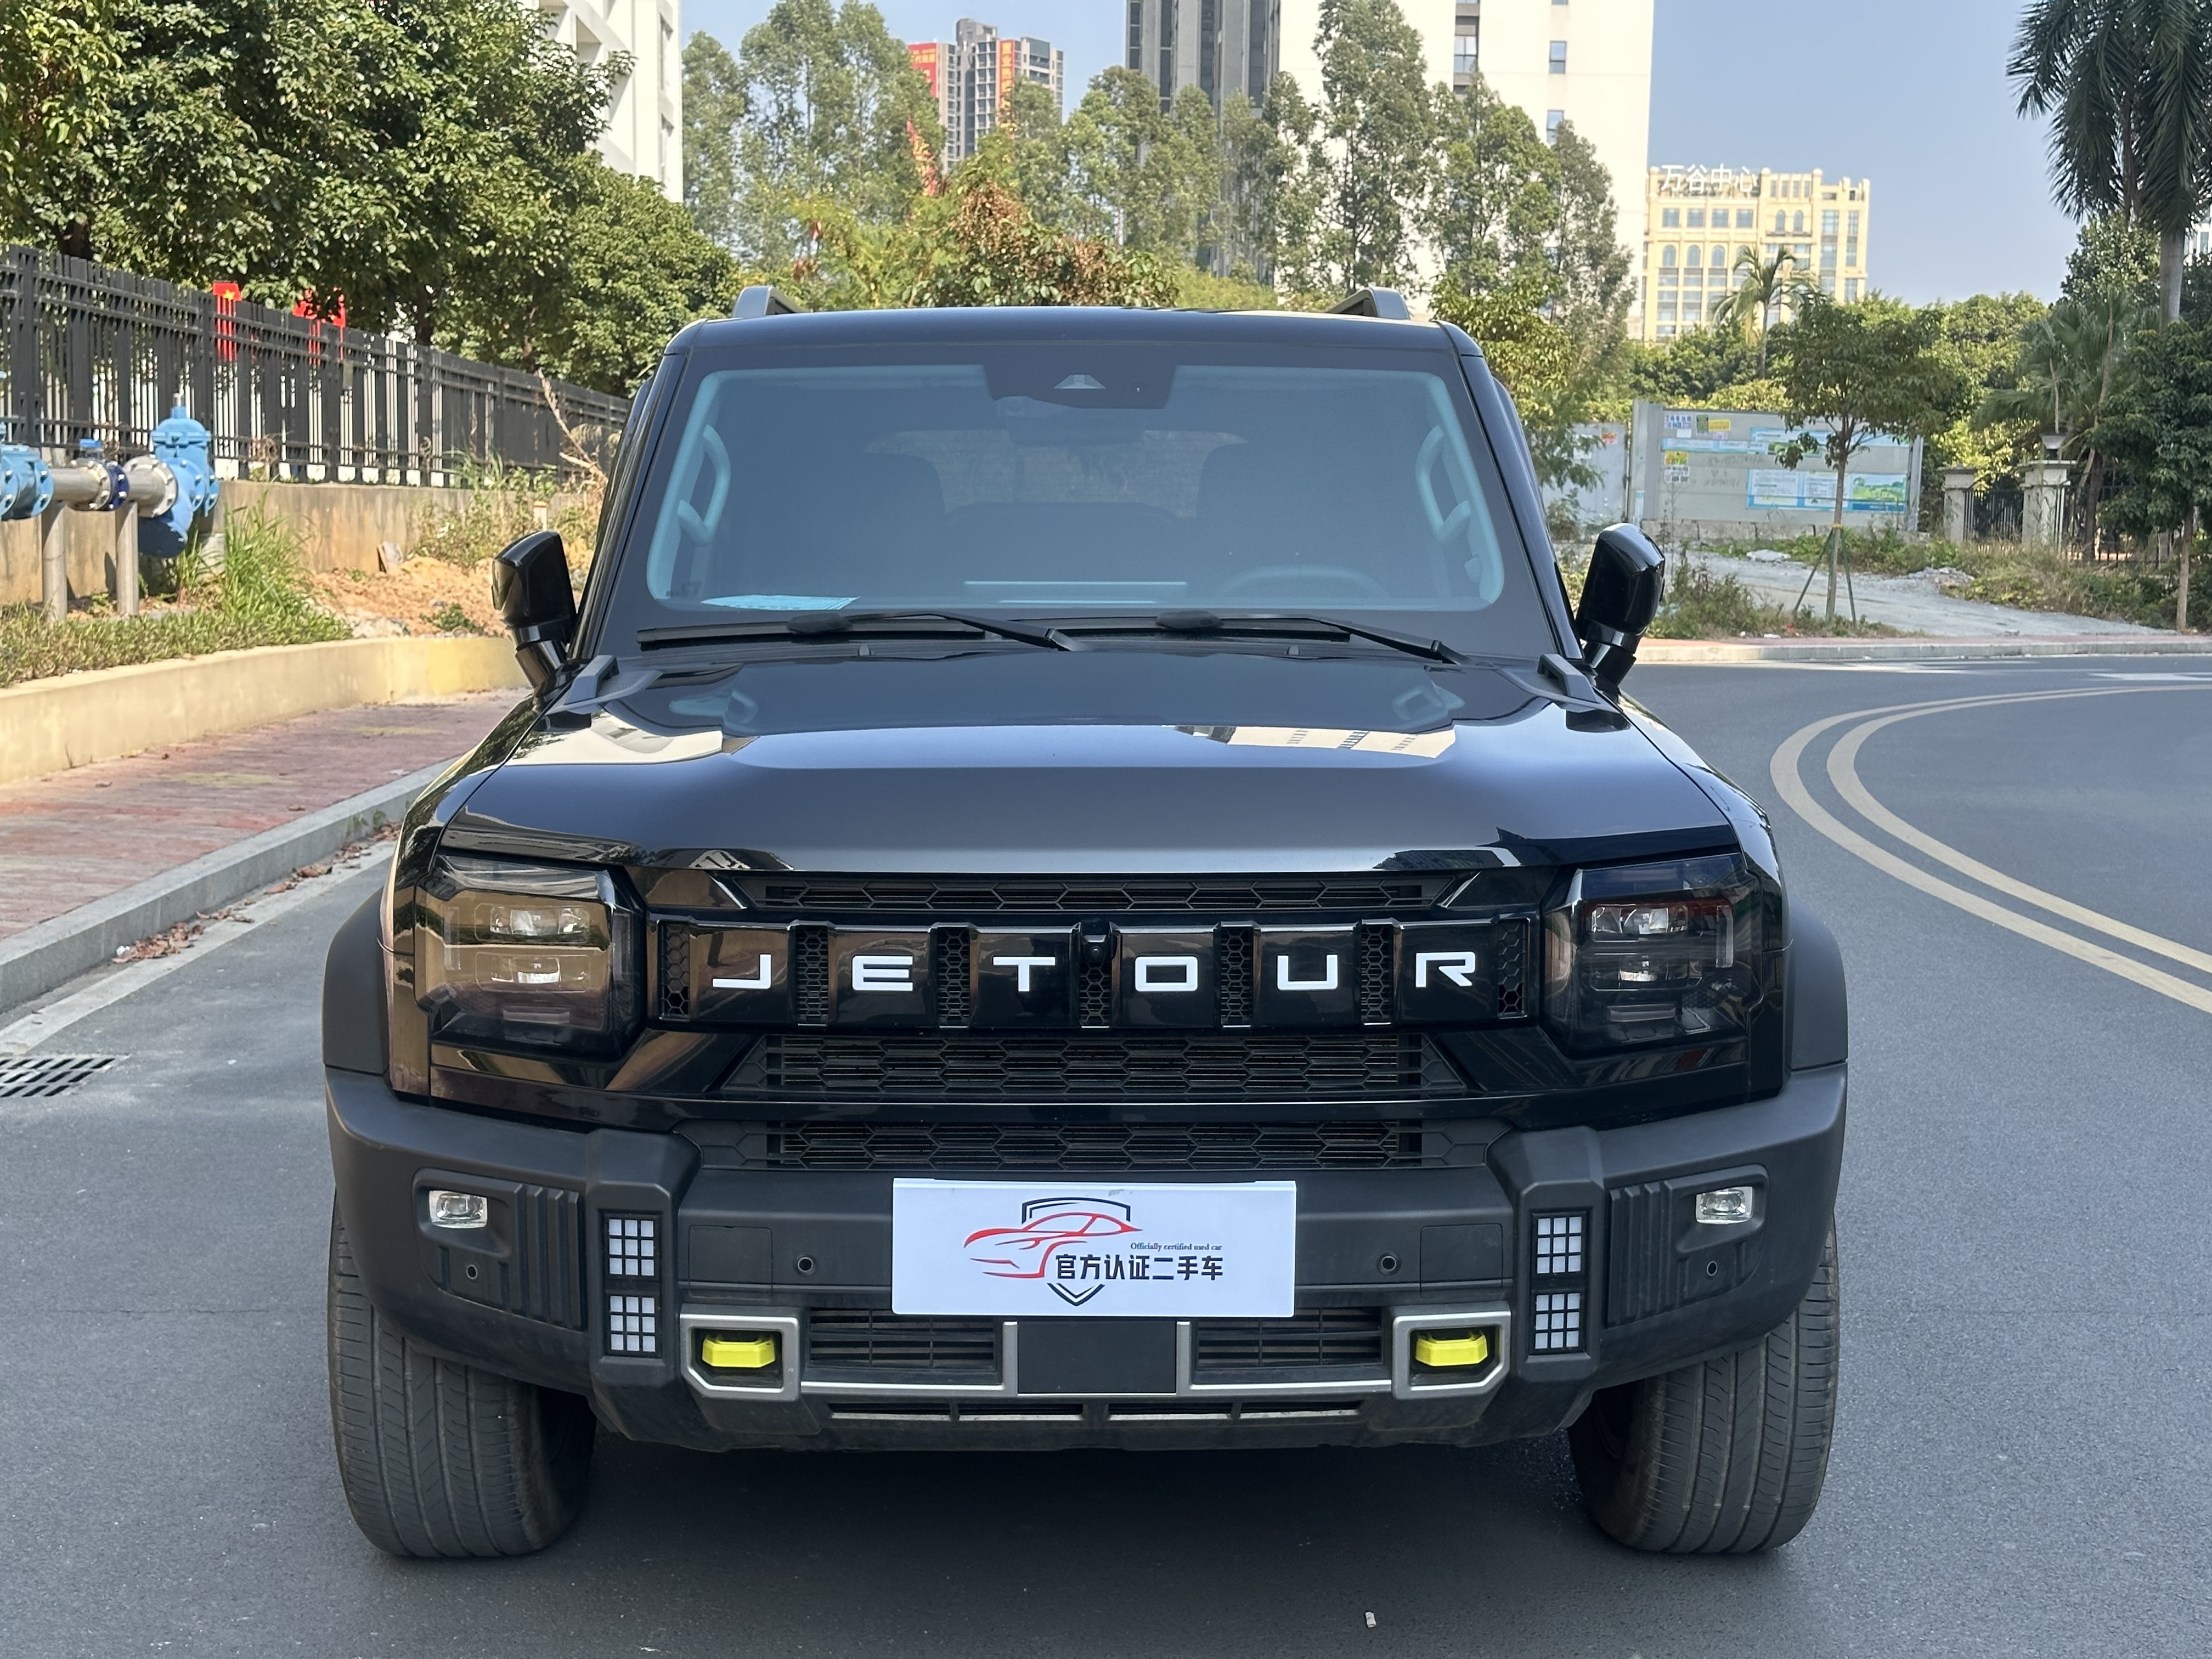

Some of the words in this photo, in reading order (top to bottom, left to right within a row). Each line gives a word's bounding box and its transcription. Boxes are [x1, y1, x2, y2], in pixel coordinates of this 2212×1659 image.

[1661, 163, 1757, 194] 万谷中心
[712, 951, 1476, 992] JETOUR
[1130, 1242, 1163, 1252] Officially
[1056, 1254, 1223, 1281] 官方认证二手车
